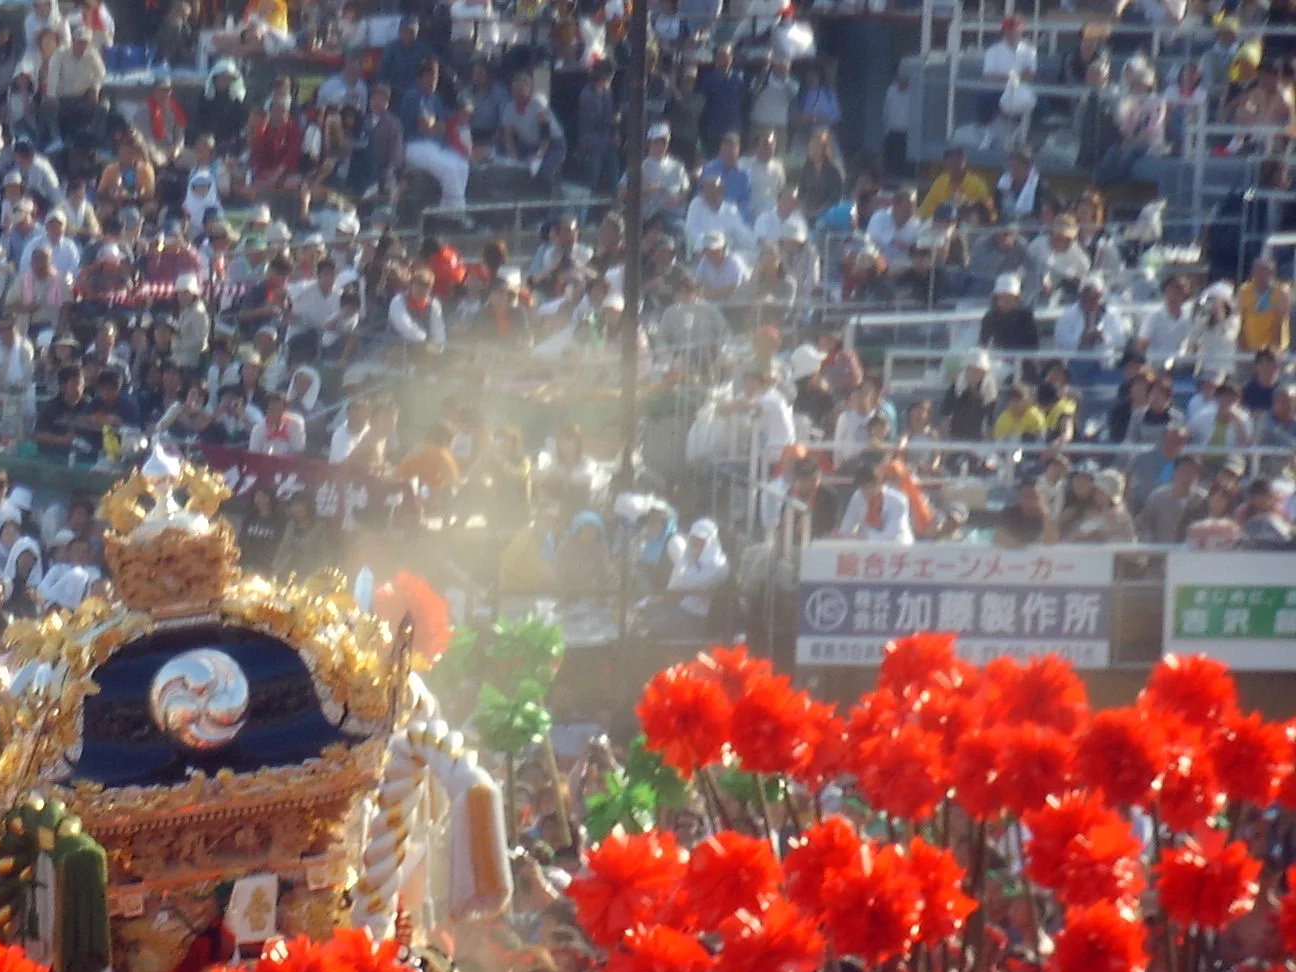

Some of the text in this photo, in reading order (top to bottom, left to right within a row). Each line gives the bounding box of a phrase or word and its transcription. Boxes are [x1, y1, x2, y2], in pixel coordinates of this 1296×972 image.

[894, 589, 1101, 635] 加藤製作所
